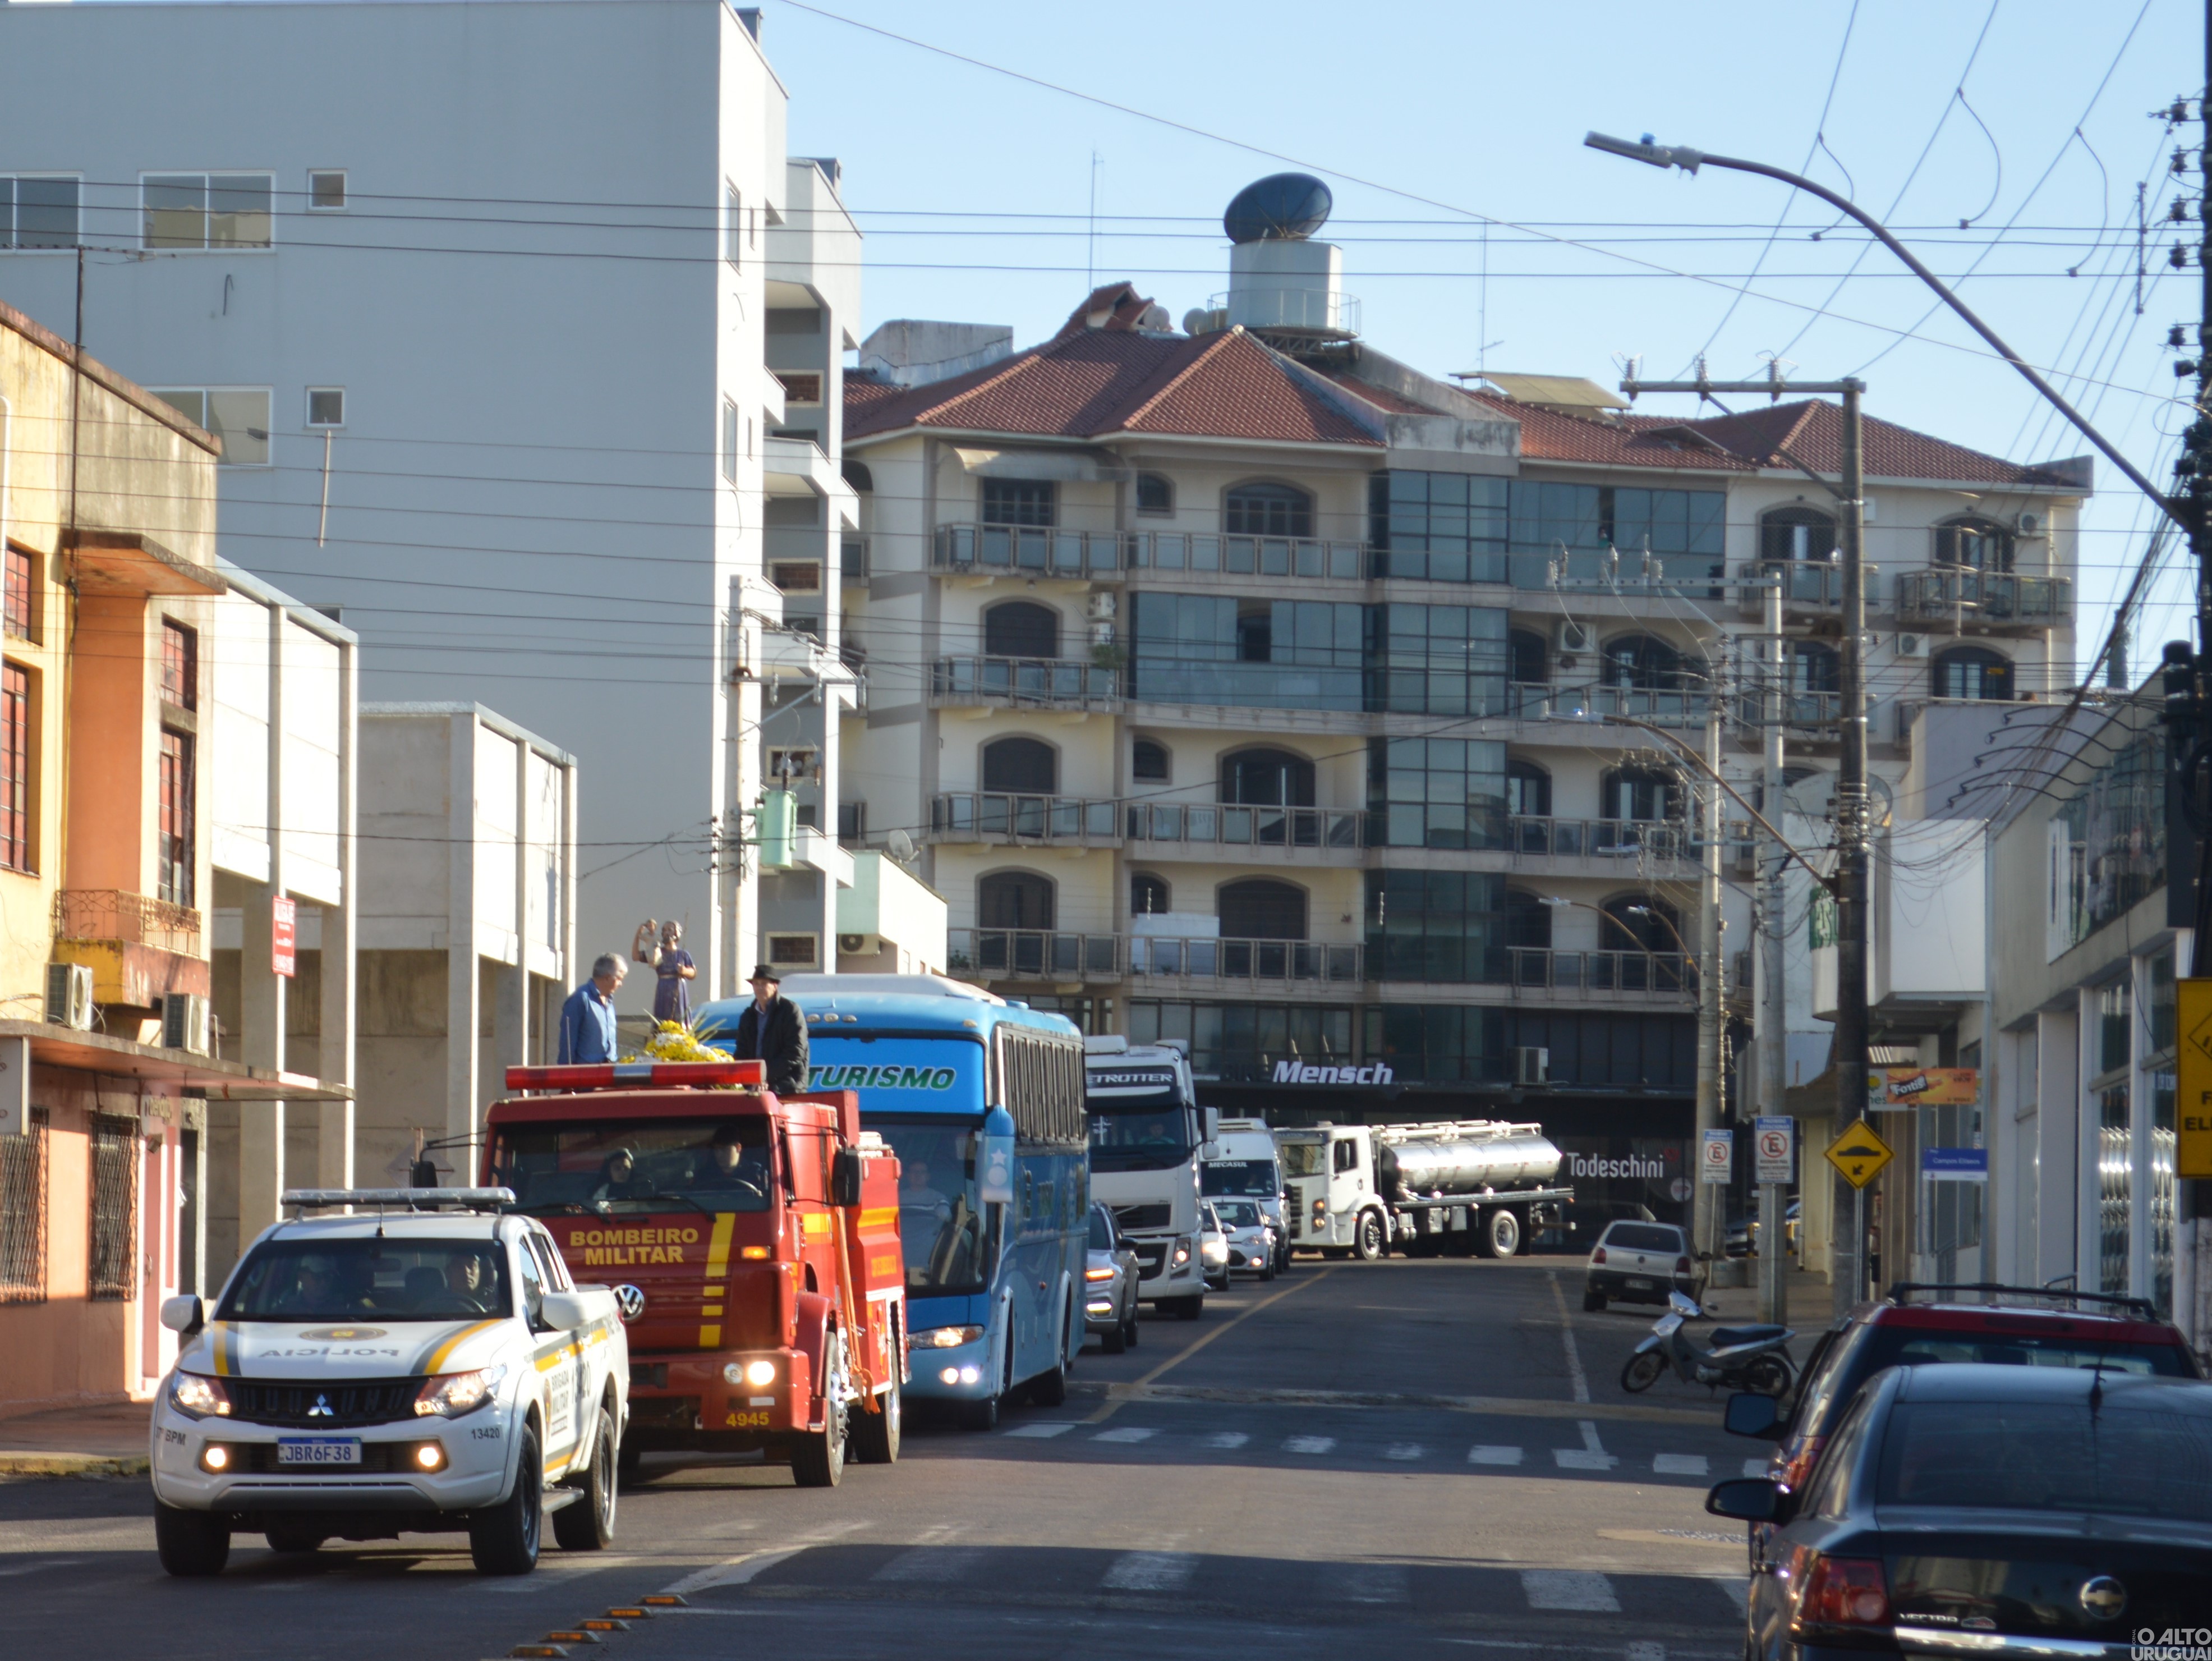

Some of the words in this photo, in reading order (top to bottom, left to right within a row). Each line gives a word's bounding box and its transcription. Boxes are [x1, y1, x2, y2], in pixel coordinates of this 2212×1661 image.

[808, 1064, 956, 1090] TURISMO
[1273, 1060, 1393, 1085] Mensch
[1566, 1152, 1663, 1178] Todeschini
[570, 1228, 698, 1246] BOMBEIRO
[585, 1245, 684, 1265] MILITAR
[726, 1412, 769, 1426] 4945
[165, 1429, 186, 1446] BPM
[471, 1428, 500, 1440] 13420
[286, 1446, 351, 1461] JBR6F38
